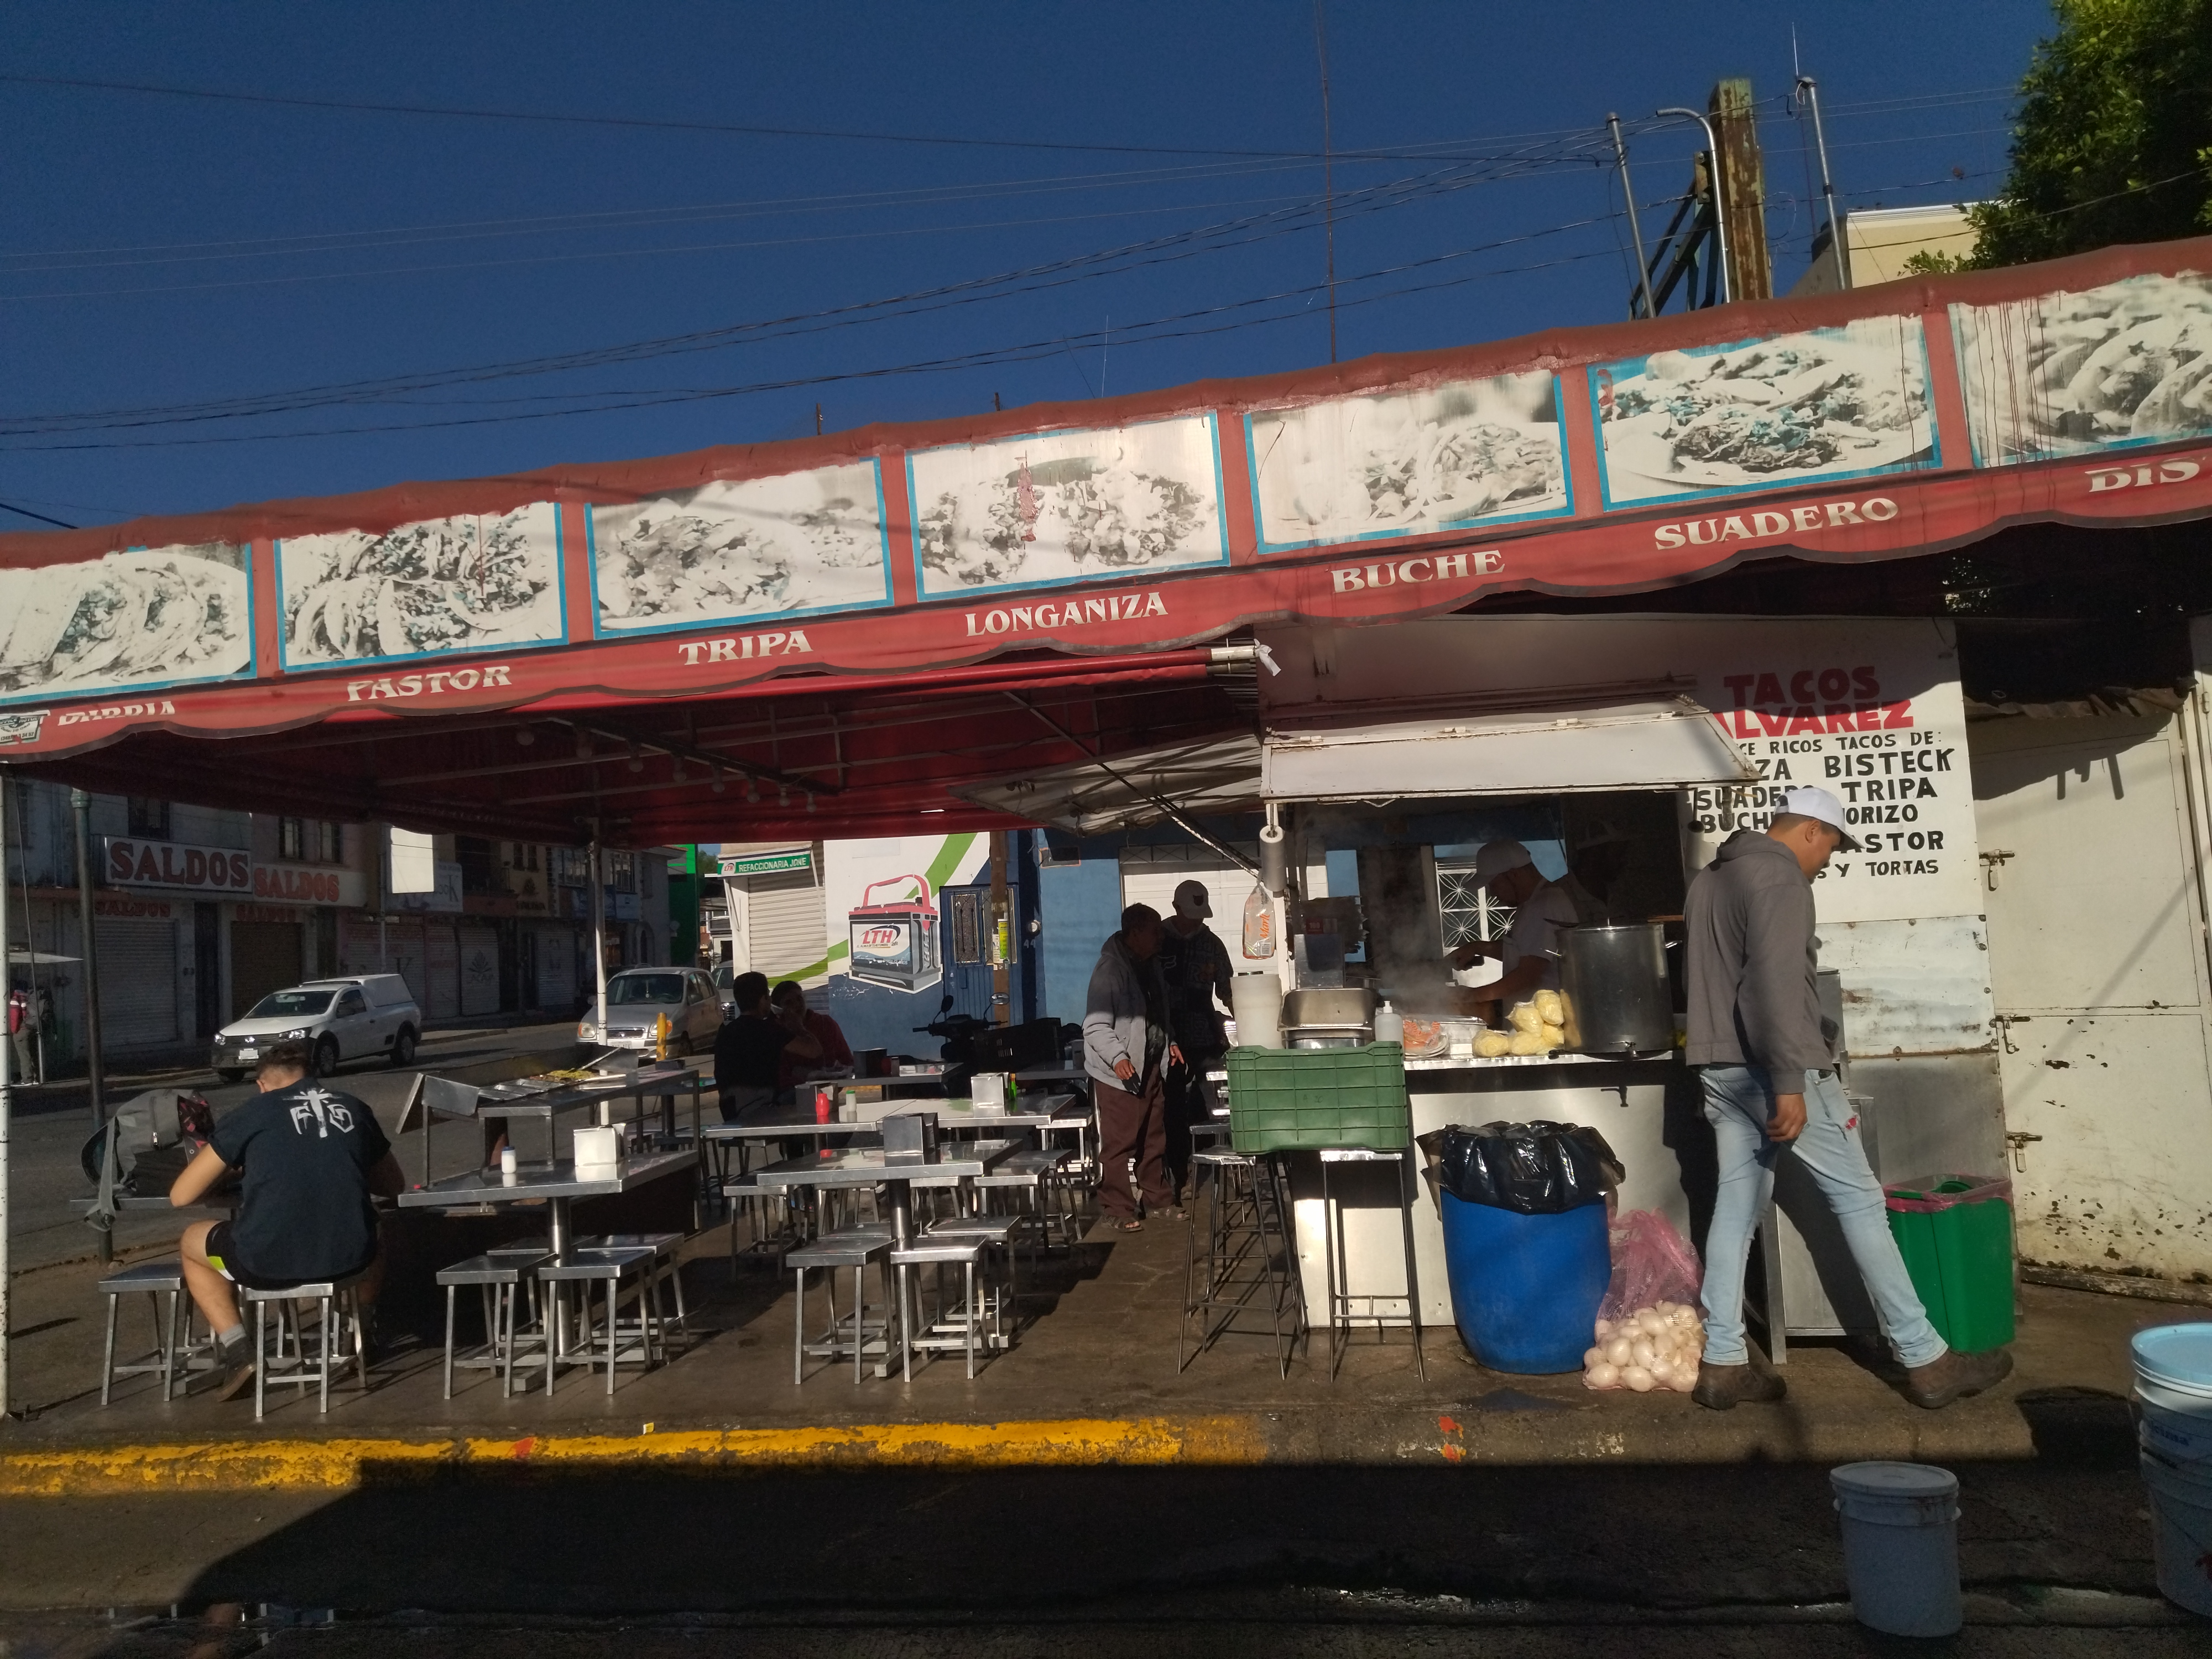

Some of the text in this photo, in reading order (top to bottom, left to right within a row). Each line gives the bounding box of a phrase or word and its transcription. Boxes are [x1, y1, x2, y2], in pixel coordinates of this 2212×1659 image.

[2085, 456, 2206, 492] DIS
[1654, 497, 1899, 551] SUADERO
[1331, 549, 1505, 593] BUCHE
[965, 592, 1168, 638] LONGANIZA
[677, 630, 813, 665] TRIPA
[347, 666, 513, 702] PASTOR
[1724, 666, 1880, 707] TACOS
[1770, 739, 1823, 754] RICOS
[1835, 734, 1896, 751] TACOS
[1911, 731, 1942, 746] DE:
[1824, 748, 1955, 778] BISTECK
[1697, 777, 1938, 811] SUADE TRIPA
[1700, 804, 1918, 834] BUCH ORIZO
[110, 842, 248, 888] SALDOS
[739, 860, 789, 872] REFACCIONARIA
[1835, 863, 1850, 878] Y
[1865, 859, 1939, 877] TORTAS
[254, 868, 340, 902] SALDOS
[95, 899, 171, 917] SALDOS
[862, 930, 893, 943] LTH
